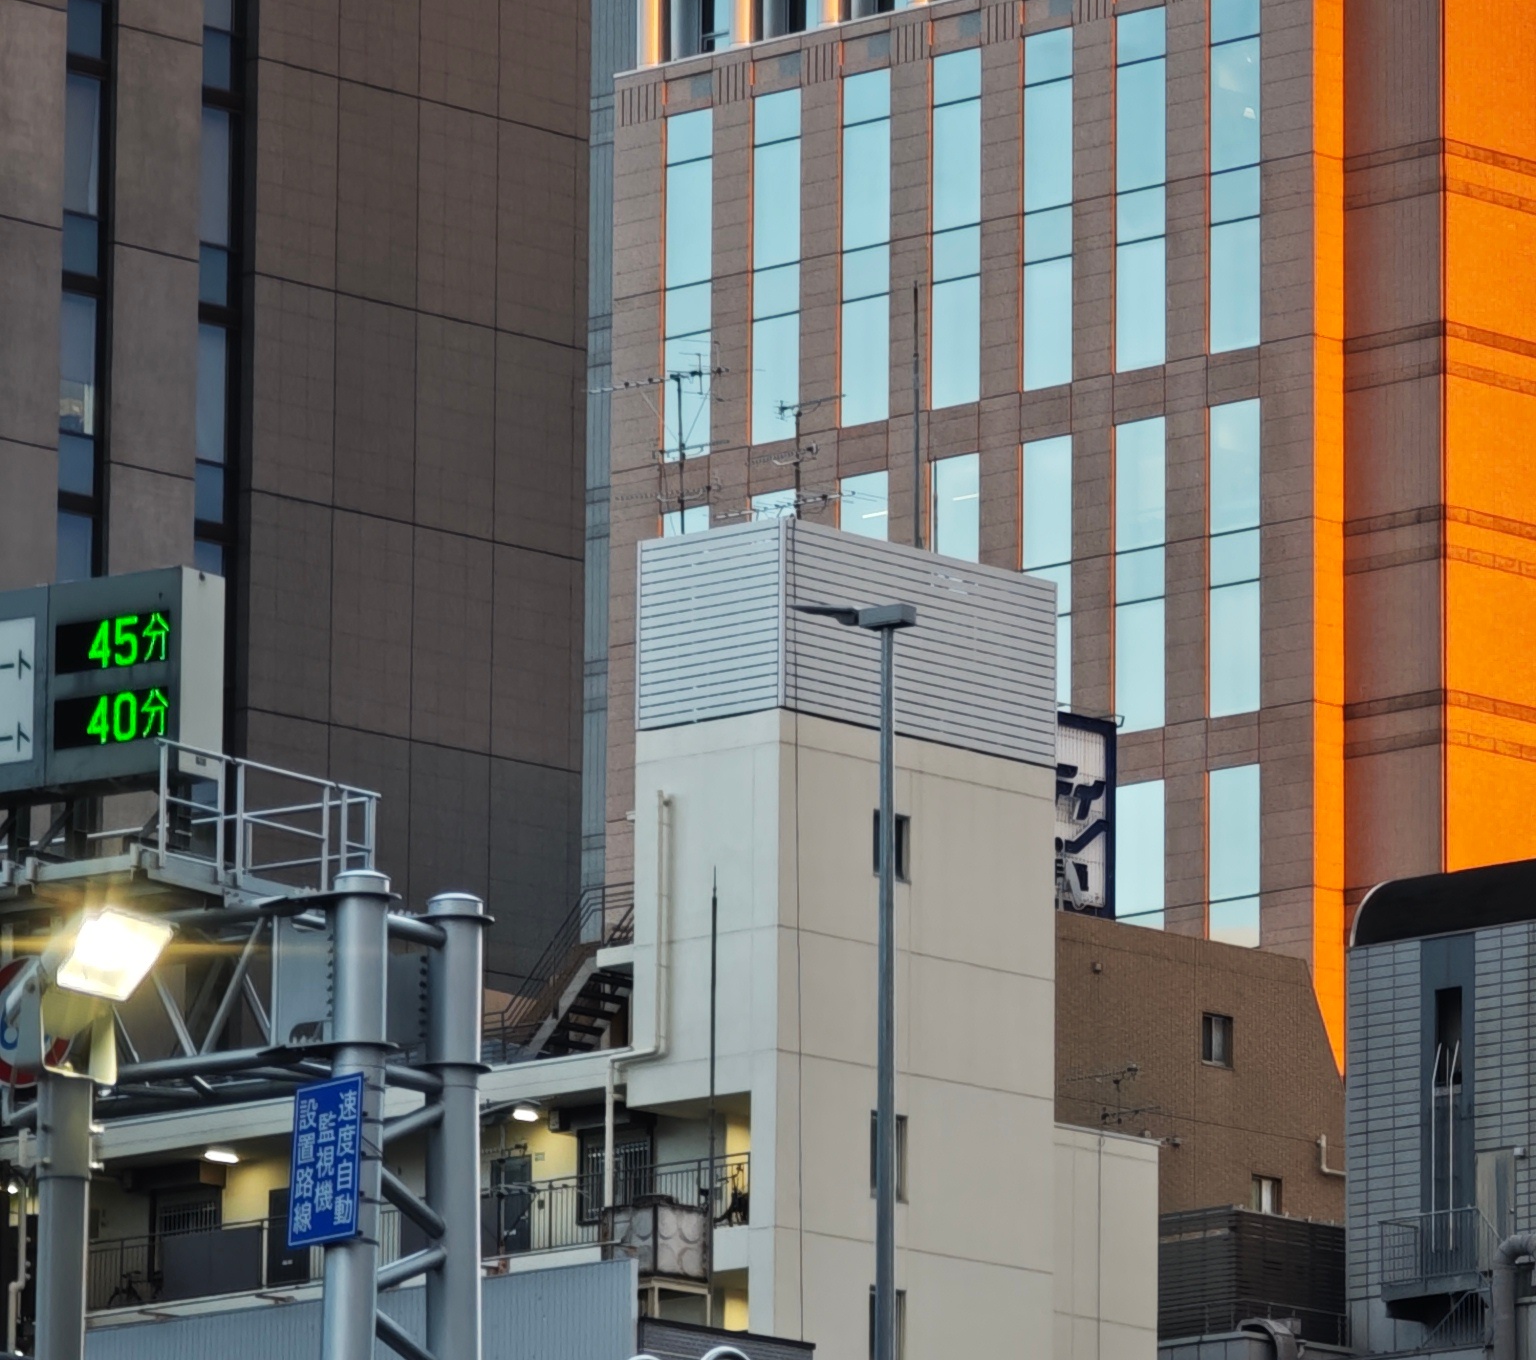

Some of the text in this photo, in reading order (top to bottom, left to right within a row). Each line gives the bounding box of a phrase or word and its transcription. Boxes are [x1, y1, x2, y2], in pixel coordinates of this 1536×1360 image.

[88, 612, 170, 669] 45分
[86, 688, 169, 744] 40分
[293, 1098, 318, 1235] 設置路線
[314, 1111, 337, 1214] 監視機
[333, 1089, 357, 1226] 速度自動
